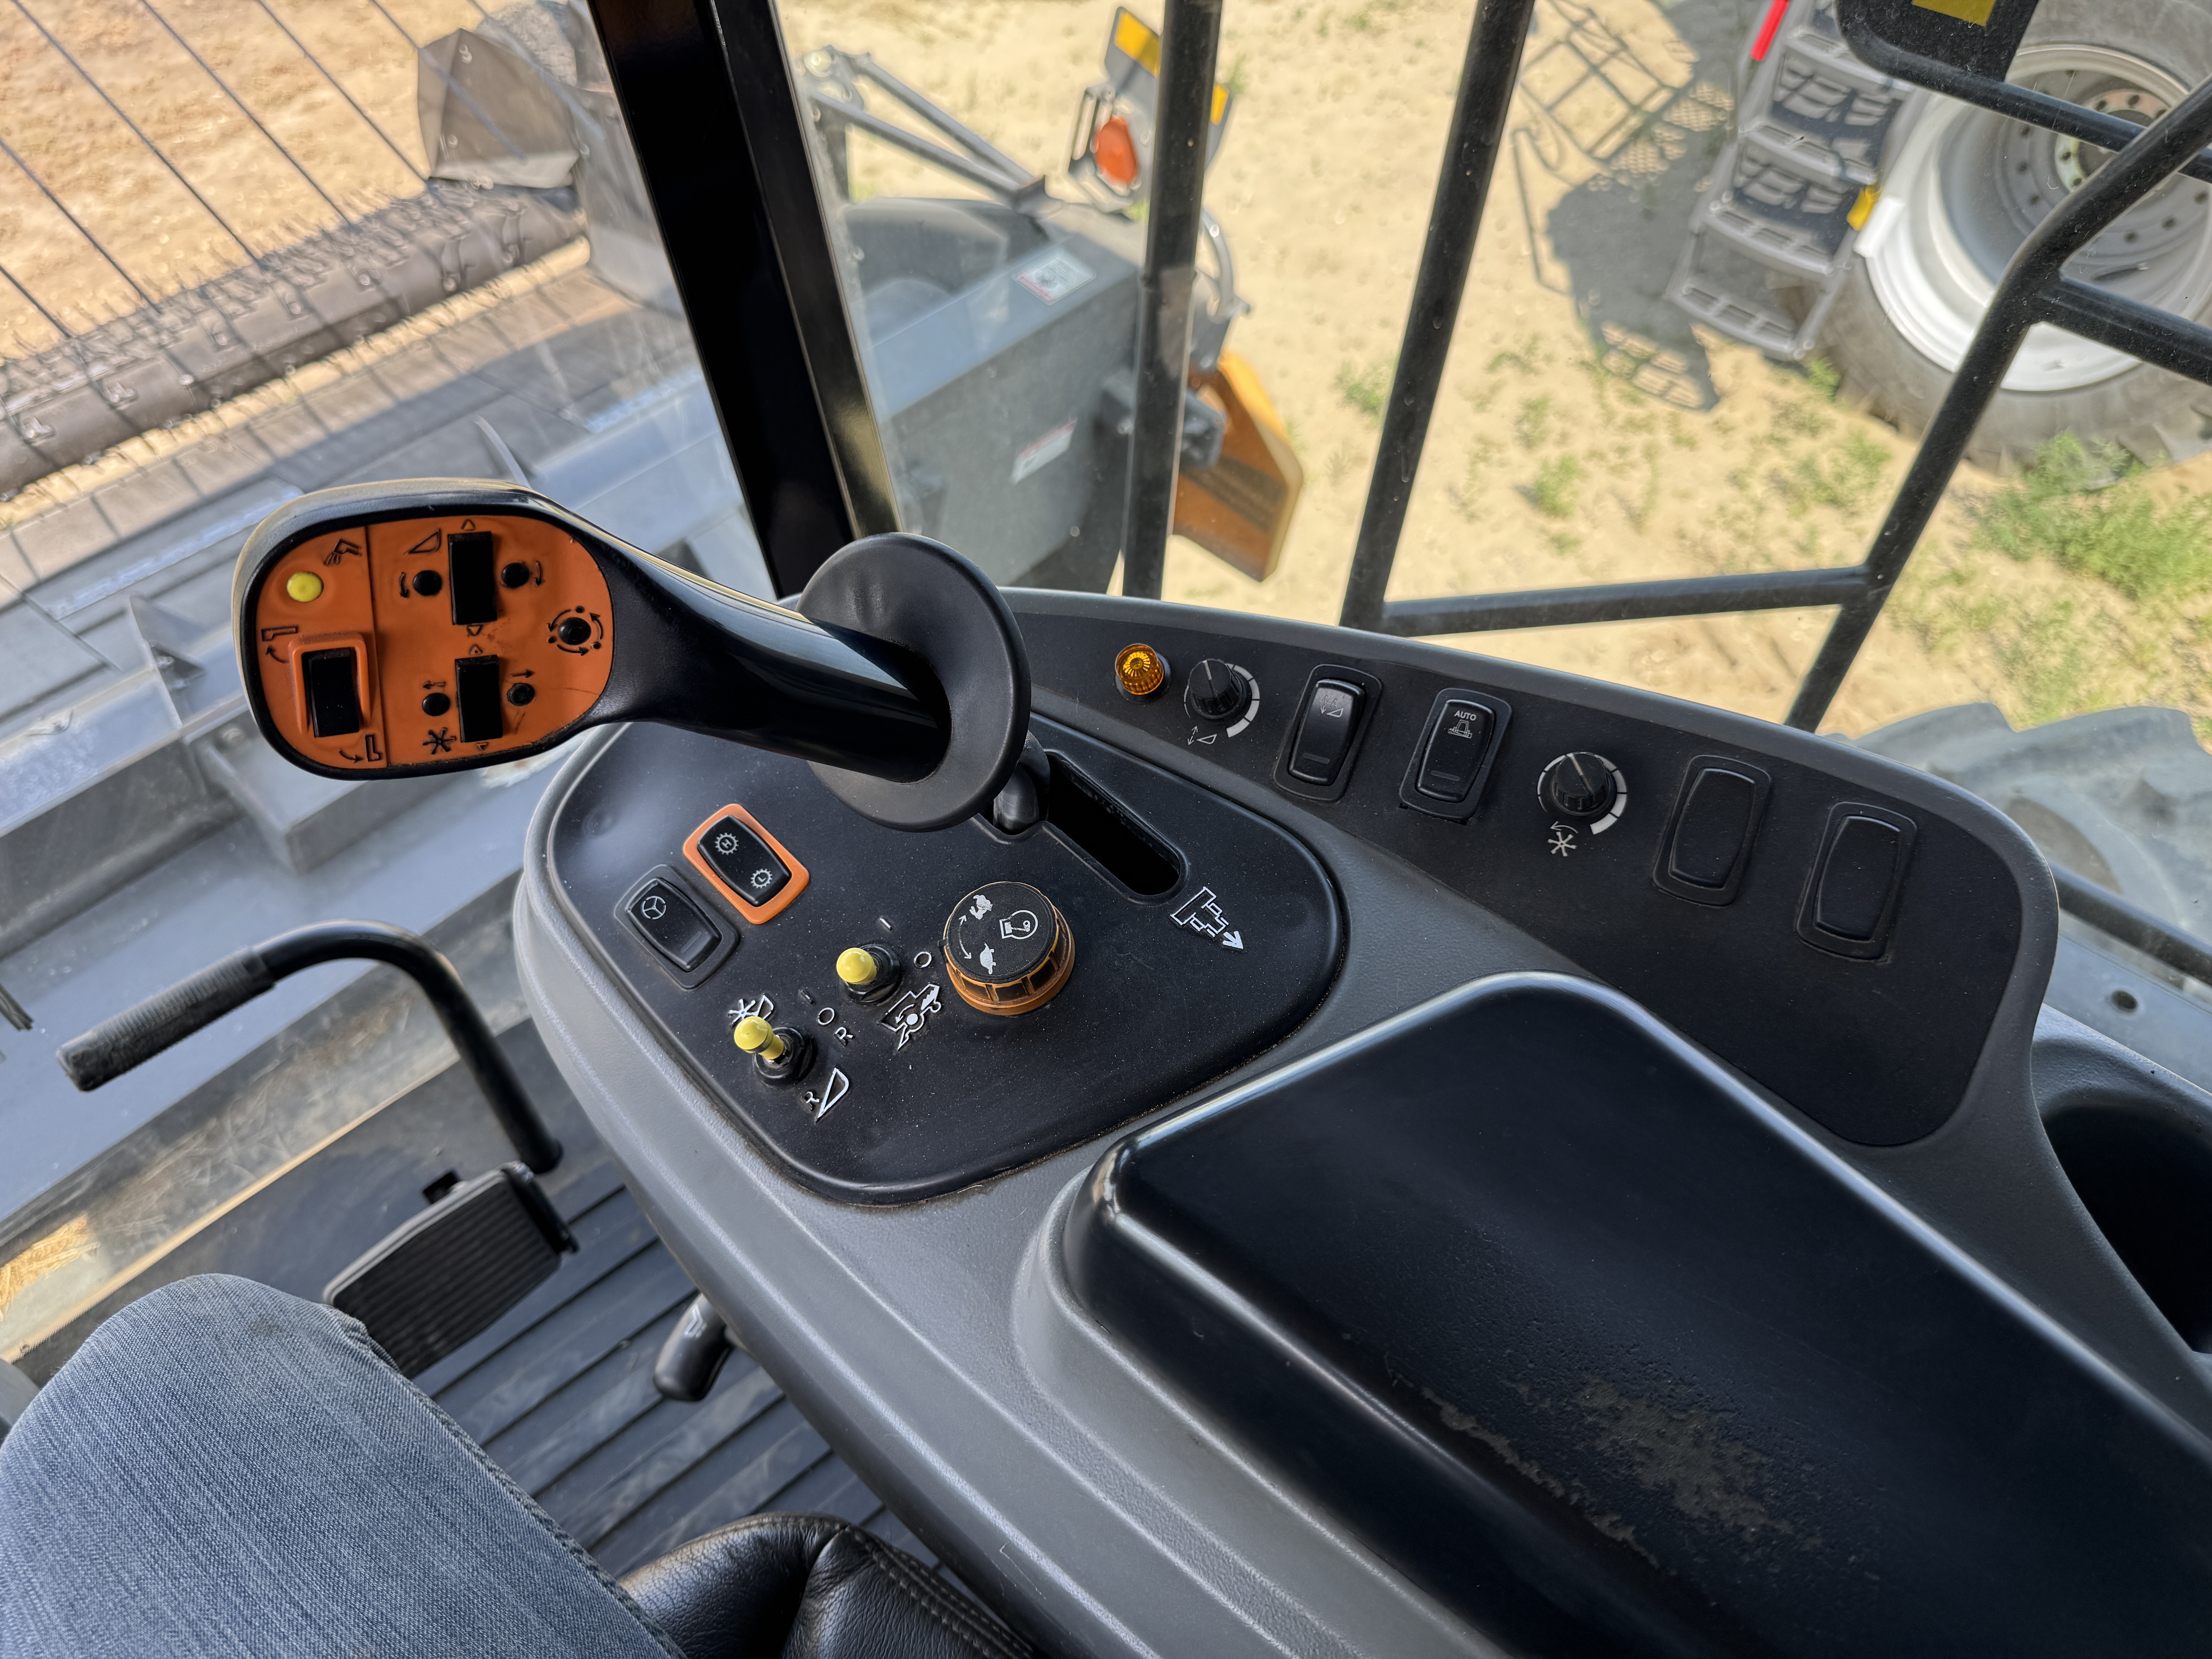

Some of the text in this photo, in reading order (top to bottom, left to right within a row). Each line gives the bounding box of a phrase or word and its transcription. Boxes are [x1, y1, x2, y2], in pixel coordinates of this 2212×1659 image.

[1454, 710, 1476, 721] AUTO
[721, 839, 732, 849] H
[834, 1027, 855, 1046] R
[805, 1091, 820, 1111] R
